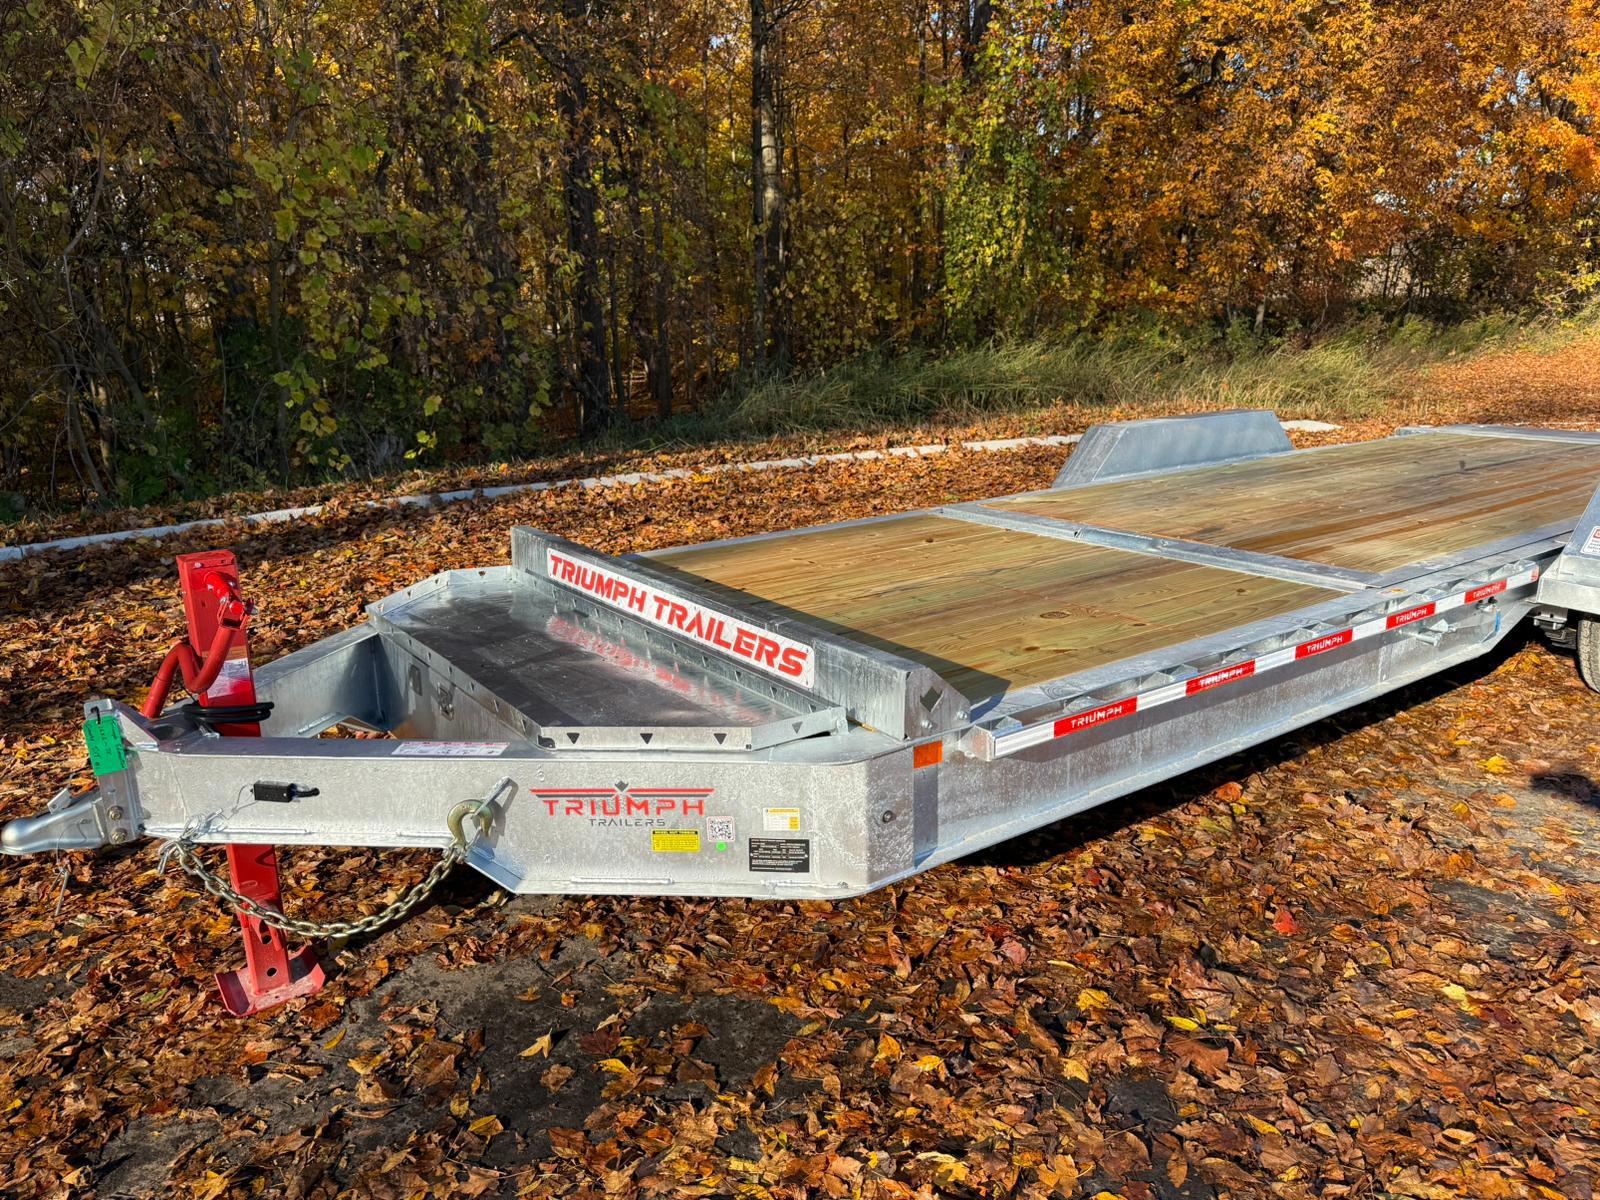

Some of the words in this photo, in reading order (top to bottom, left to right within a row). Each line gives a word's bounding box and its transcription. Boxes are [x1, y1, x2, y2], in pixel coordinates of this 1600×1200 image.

[1473, 583, 1503, 599] TRIUMPH
[550, 555, 646, 613] TRIUMPH
[652, 595, 808, 676] TRAILERS
[1396, 607, 1427, 624] TRIUMPH
[1307, 635, 1343, 653] TRIUMPH
[1199, 667, 1244, 687] TRIUMPH
[1071, 705, 1123, 728] TRIUMPH
[542, 797, 705, 816] TRIUMPH
[590, 818, 666, 827] TRAILERS
